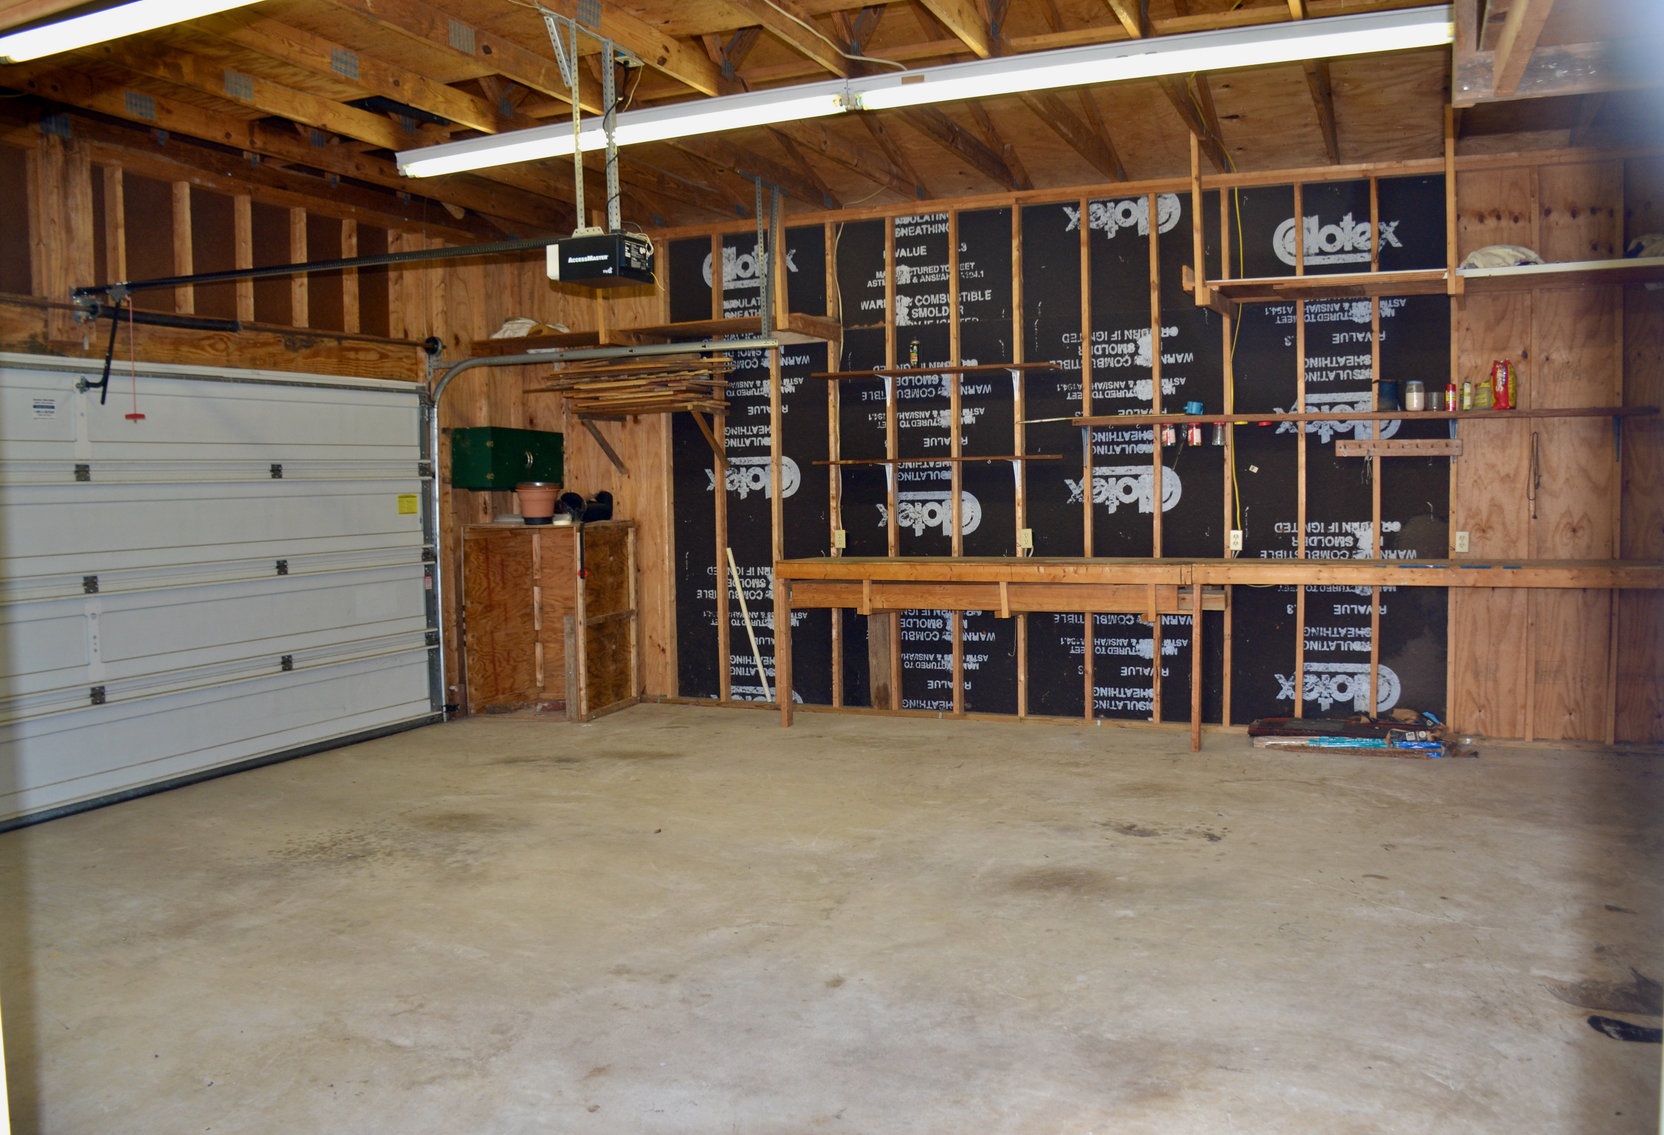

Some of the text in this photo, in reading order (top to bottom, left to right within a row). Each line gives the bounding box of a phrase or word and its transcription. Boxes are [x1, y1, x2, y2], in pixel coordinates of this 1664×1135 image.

[914, 289, 992, 306] COMBUTIBLE
[1111, 331, 1121, 341] IF
[747, 405, 771, 415] ALUE
[724, 424, 771, 436] HEATHING
[923, 436, 950, 447] ALUE
[1328, 522, 1339, 532] IF
[1260, 550, 1349, 560] COMBUTIBLE
[1054, 613, 1134, 625] COMBUTIBLE
[926, 680, 953, 690] ALUE
[901, 700, 953, 710] HEATHING
